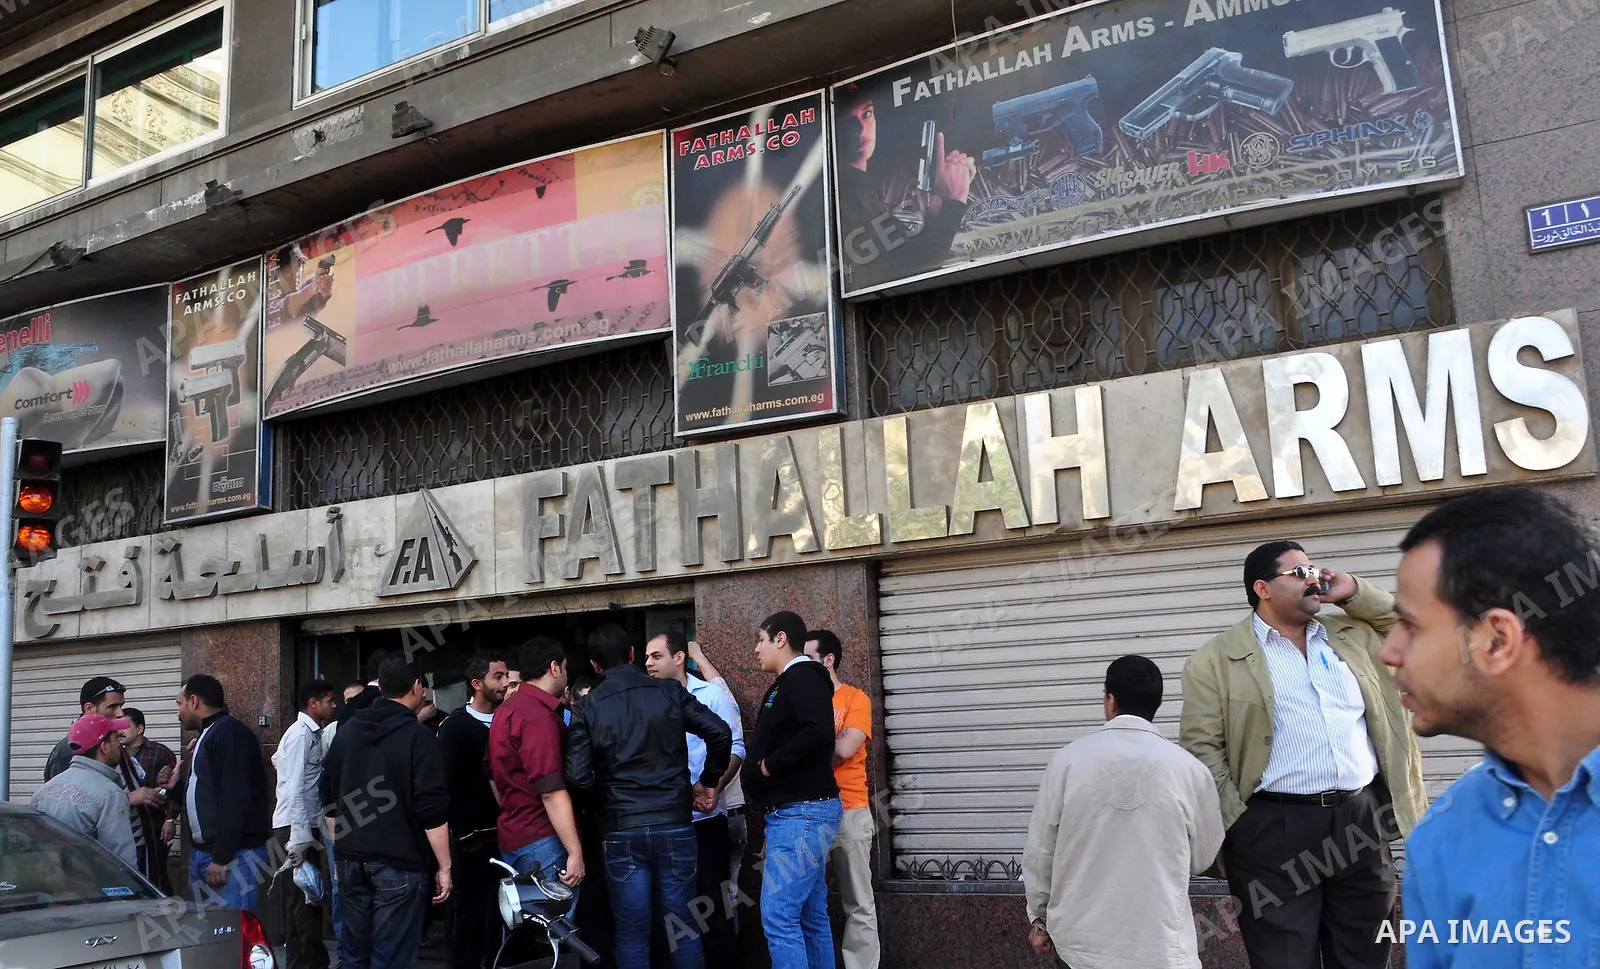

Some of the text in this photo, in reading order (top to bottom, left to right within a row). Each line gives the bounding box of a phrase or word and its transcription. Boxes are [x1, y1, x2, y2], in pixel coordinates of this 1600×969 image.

[893, 41, 1053, 108] FATHALLAH
[1060, 17, 1156, 59] ARMS
[679, 107, 816, 156] FATHALLAH
[1286, 115, 1409, 152] SPHINX
[693, 130, 801, 171] ARMS.CO
[1187, 149, 1231, 177] HK
[174, 271, 257, 306] FATHALLAH
[183, 287, 247, 317] ARMS.CO
[387, 318, 610, 375] www.fathallaharms.com.eg
[687, 350, 765, 381] Franchi
[685, 392, 825, 423] www.fathallaharms.com.eg
[521, 315, 1589, 585] FATHALLAH ARMS
[170, 492, 251, 513] www.fathharms.com.eg
[24, 545, 142, 639] فتح
